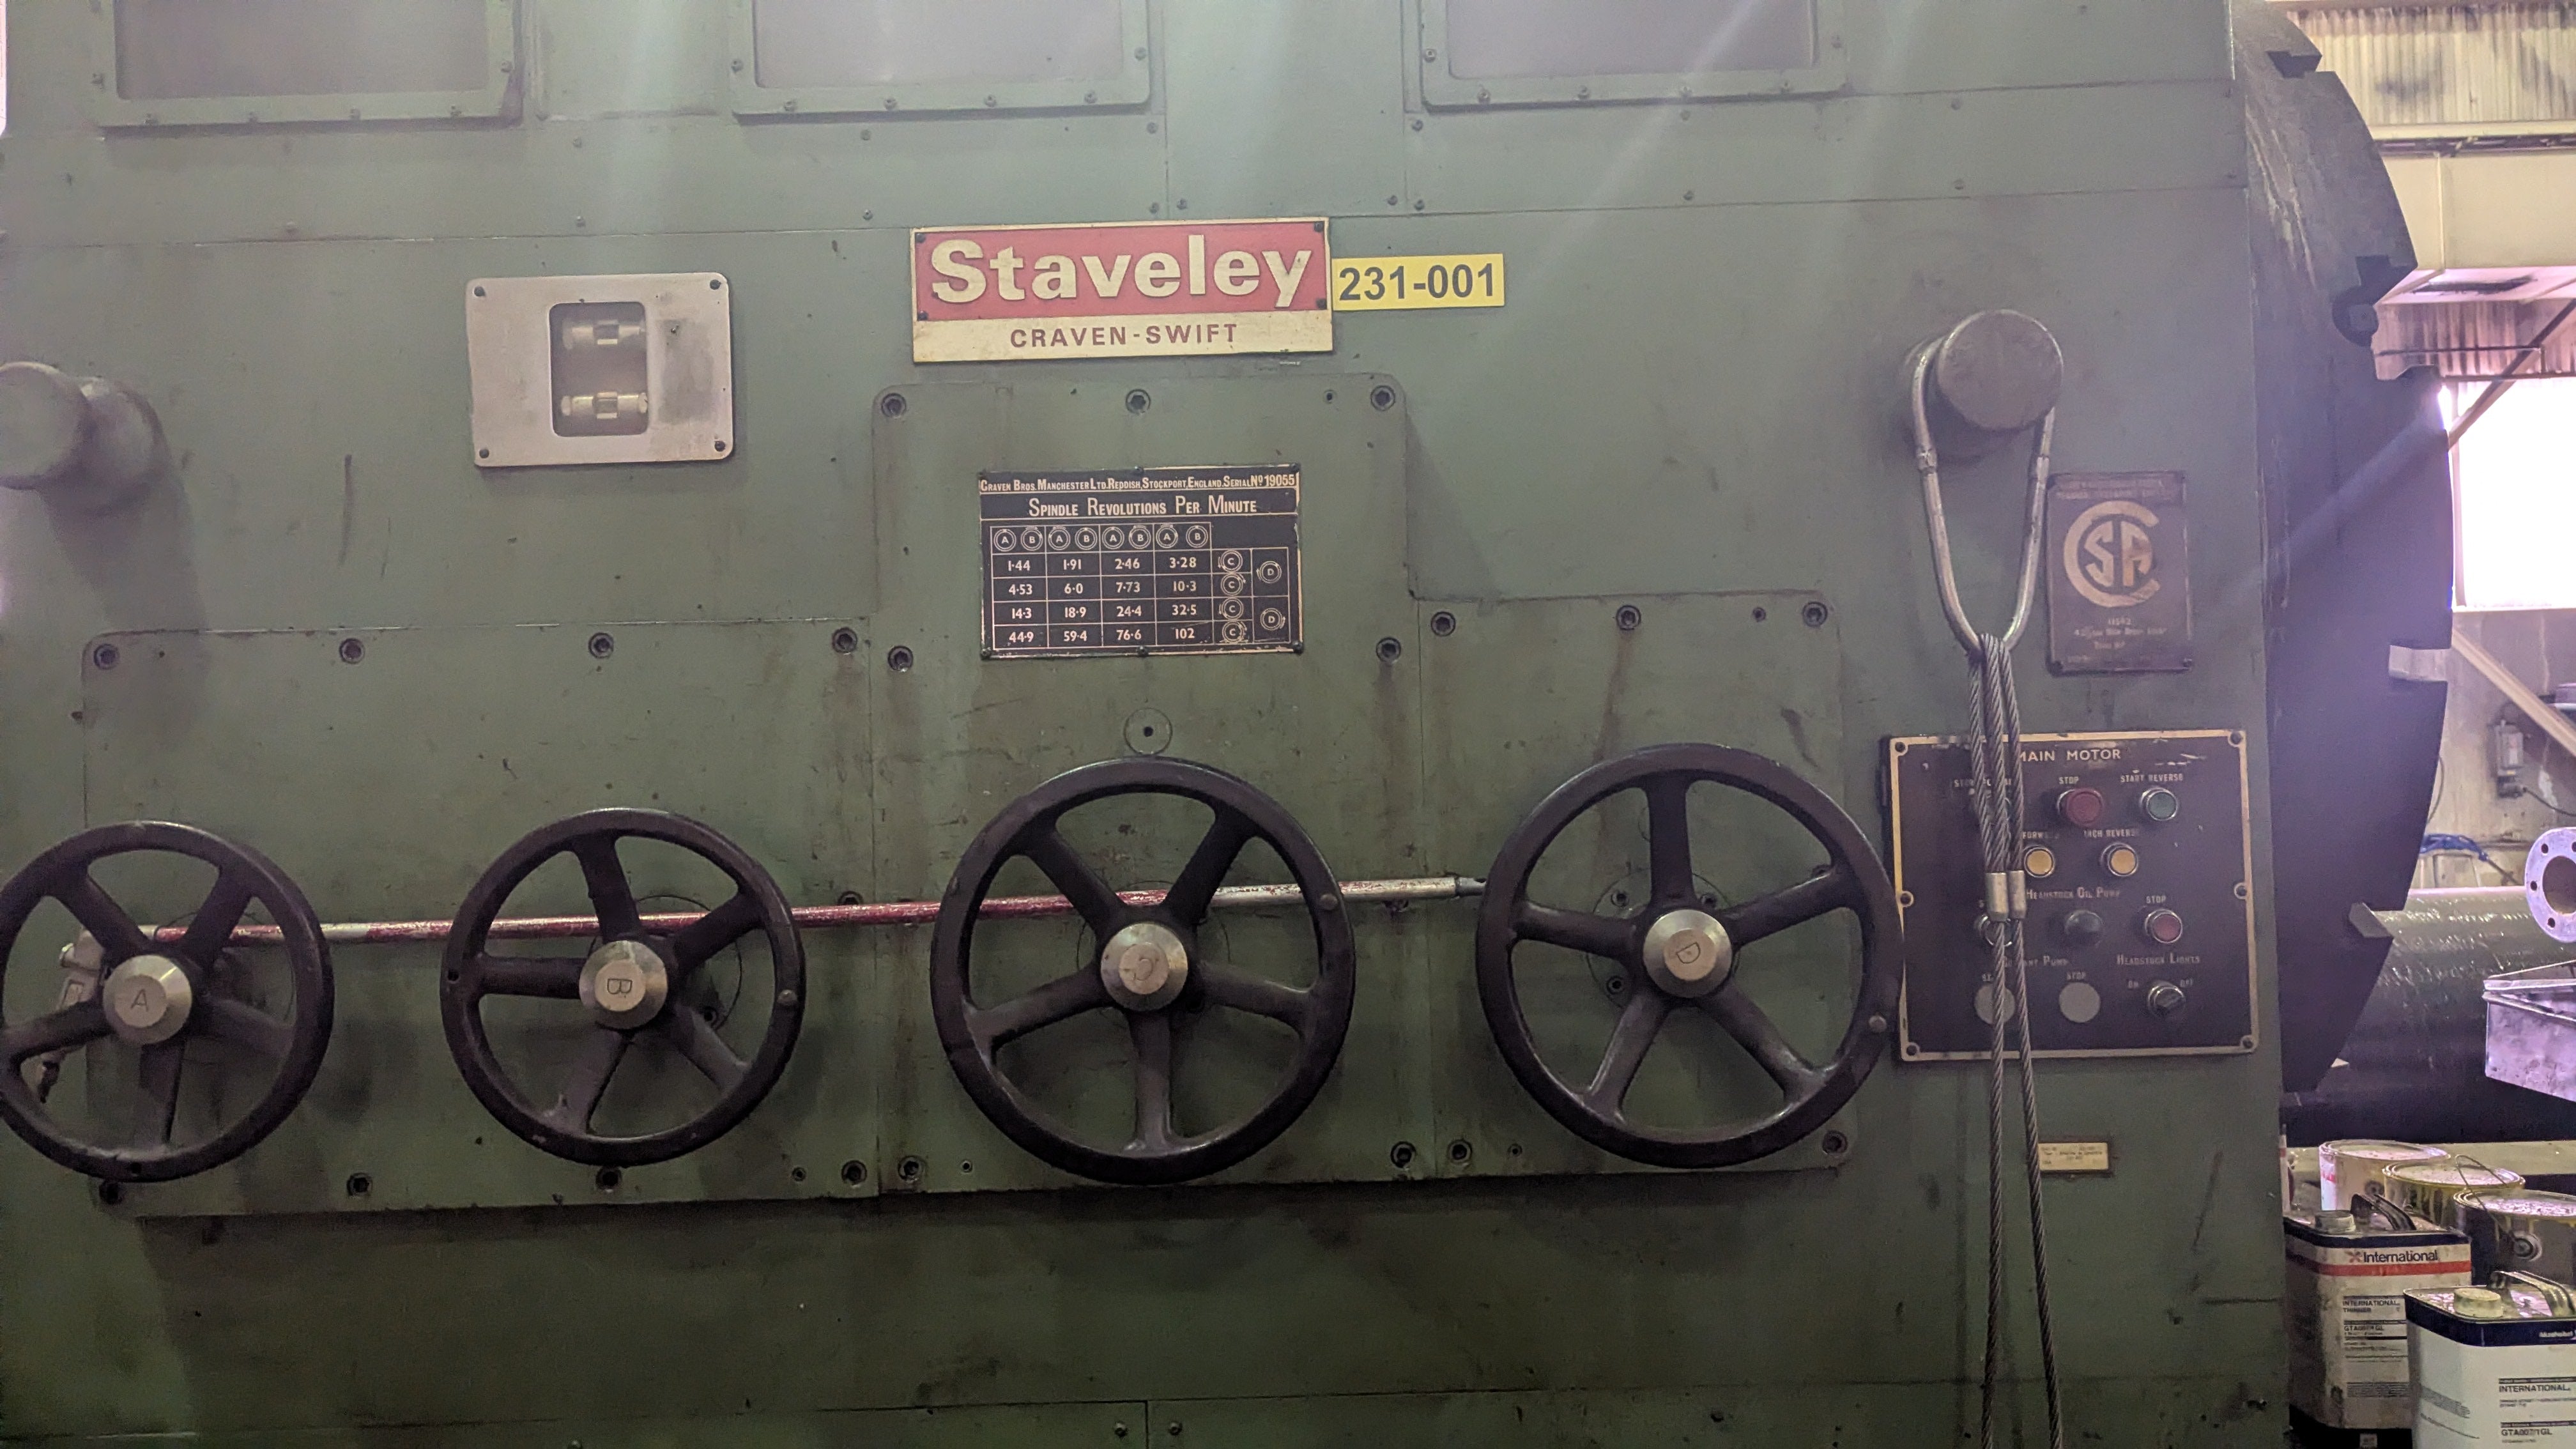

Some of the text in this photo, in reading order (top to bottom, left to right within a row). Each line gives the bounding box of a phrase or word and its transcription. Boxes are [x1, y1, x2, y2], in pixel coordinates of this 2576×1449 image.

[931, 234, 1312, 308] Staveley
[1338, 263, 1495, 302] 231-001
[1010, 323, 1238, 349] CRAVEN-SWIFT
[981, 480, 1011, 491] CRAVEN
[1038, 479, 1089, 490] MANCHESTER
[1264, 474, 1294, 486] 19055
[1029, 494, 1257, 516] SPINDLE REVOLUTIONS PER MINUTE
[1175, 628, 1195, 639] 102
[2067, 749, 2121, 761] MOTOR
[2059, 776, 2079, 785] STOP
[1676, 942, 1701, 963] D
[608, 978, 632, 995] B
[131, 989, 149, 1012] A
[2363, 1250, 2438, 1263] International
